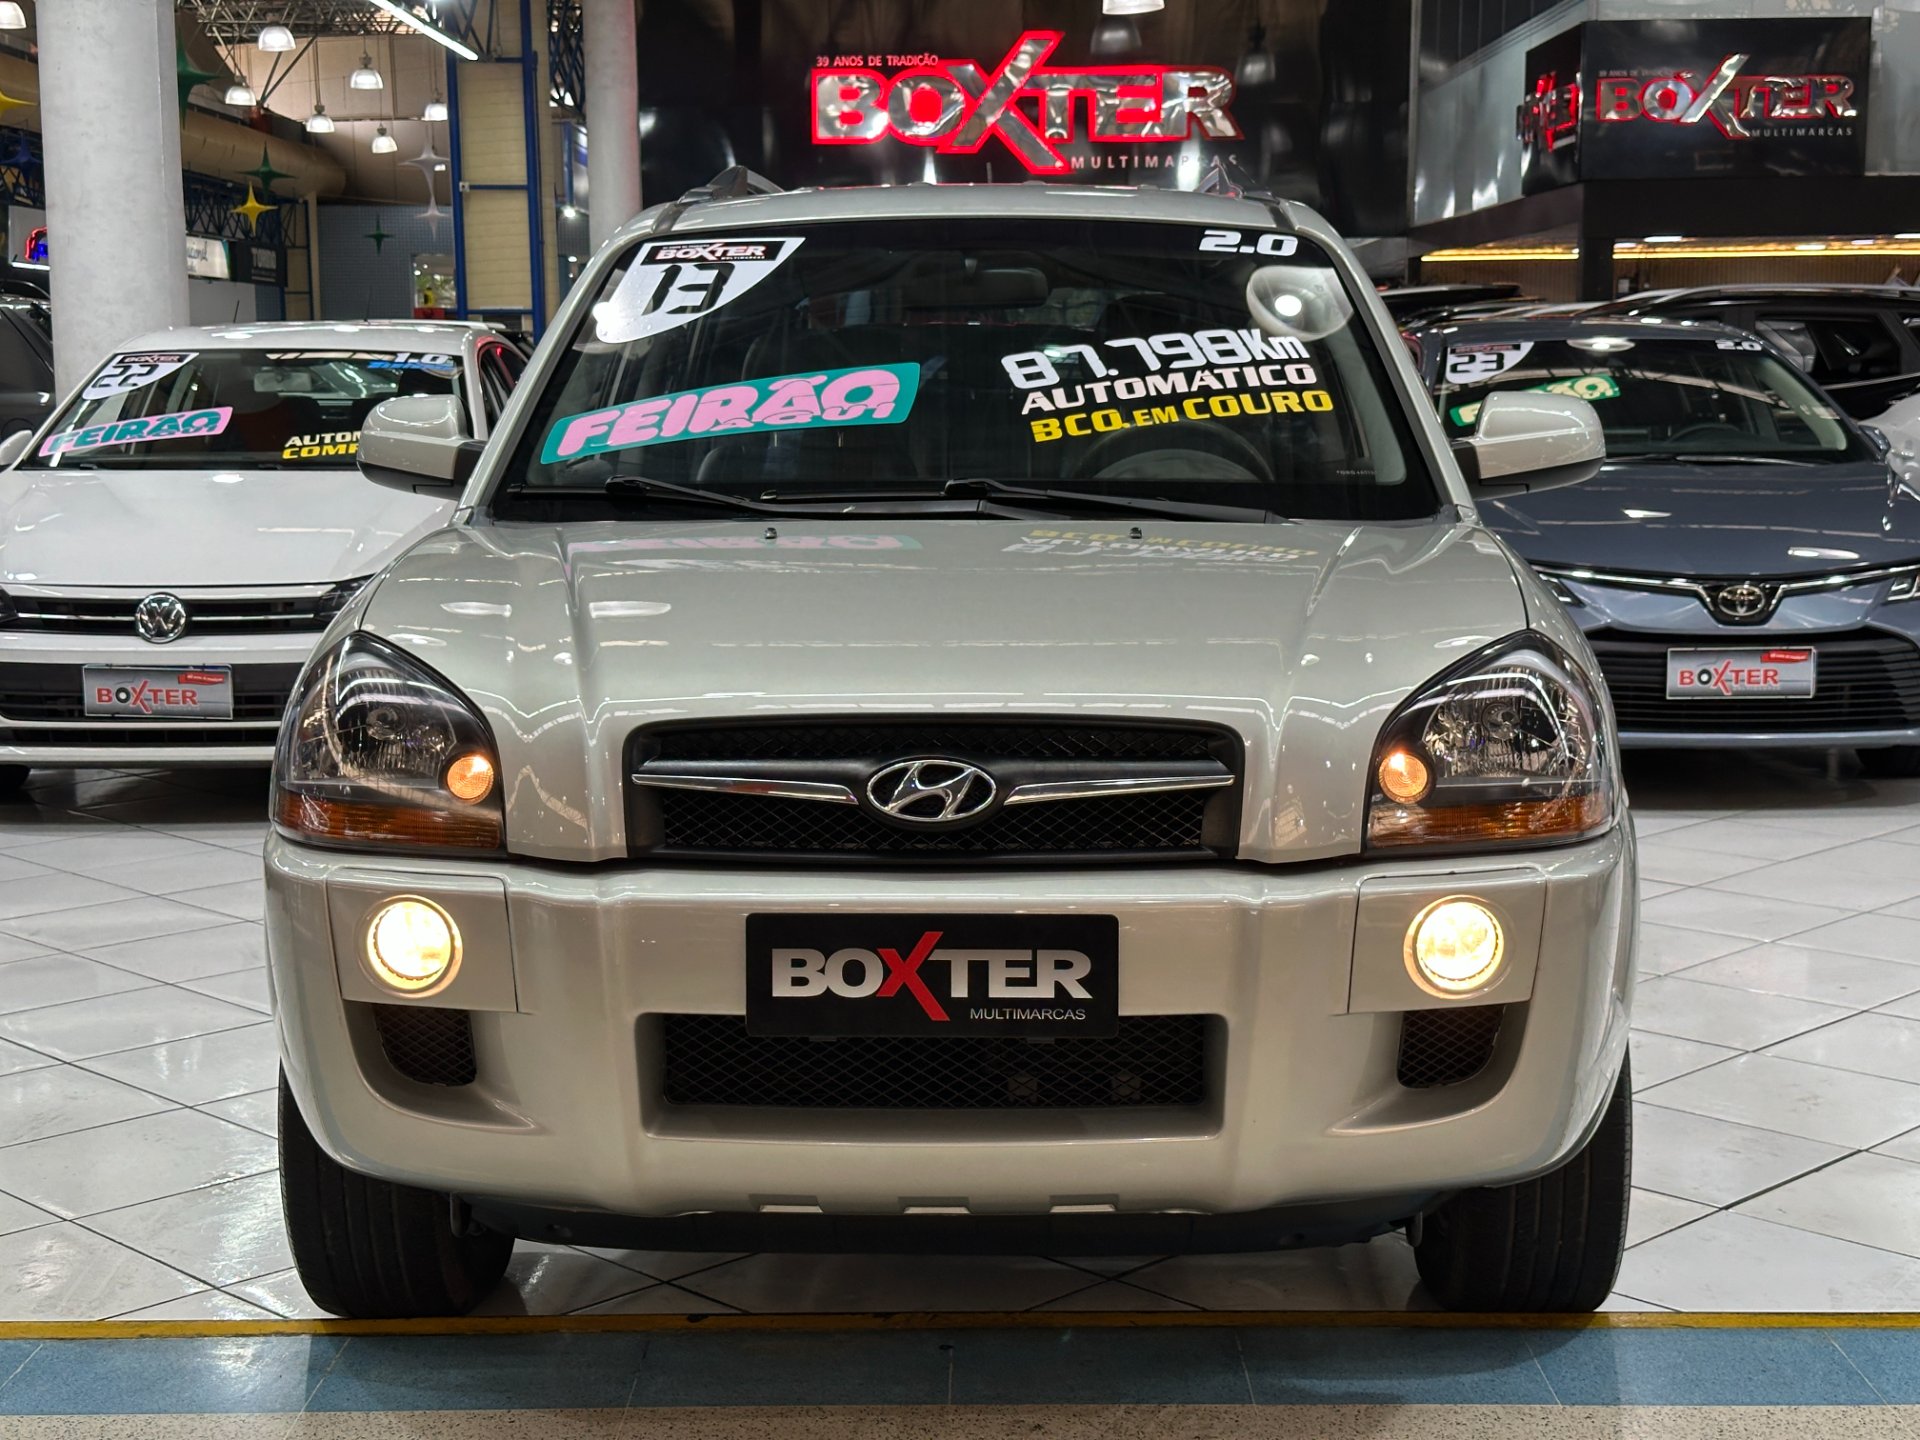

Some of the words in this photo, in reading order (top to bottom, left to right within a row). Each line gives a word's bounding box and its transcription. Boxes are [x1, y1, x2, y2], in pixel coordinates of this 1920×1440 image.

[816, 56, 829, 67] 39
[833, 55, 864, 67] ANOS
[868, 55, 882, 67] DE
[886, 52, 938, 66] TRADIÇÃO
[812, 31, 1244, 174] BOXTER
[1597, 53, 1857, 139] BOXTER
[1751, 128, 1852, 137] MULTIMARCAS
[1071, 154, 1237, 169] MULTIMARAS
[655, 243, 766, 260] BOXTER
[1199, 230, 1298, 256] 2.0
[641, 262, 735, 316] 13
[394, 352, 450, 365] 1.0
[1715, 340, 1762, 351] 2.0
[1450, 352, 1505, 373] 23
[91, 364, 160, 388] 22
[557, 370, 900, 456] FEIRÃO
[1136, 405, 1180, 427] EM
[1183, 390, 1334, 420] COURO
[48, 411, 221, 453] FEIRÃO
[1678, 659, 1780, 695] BOXTER
[96, 680, 198, 714] BOXTER
[772, 931, 1093, 1022] BOXTER
[970, 1008, 1086, 1021] MULTIMARCAS
